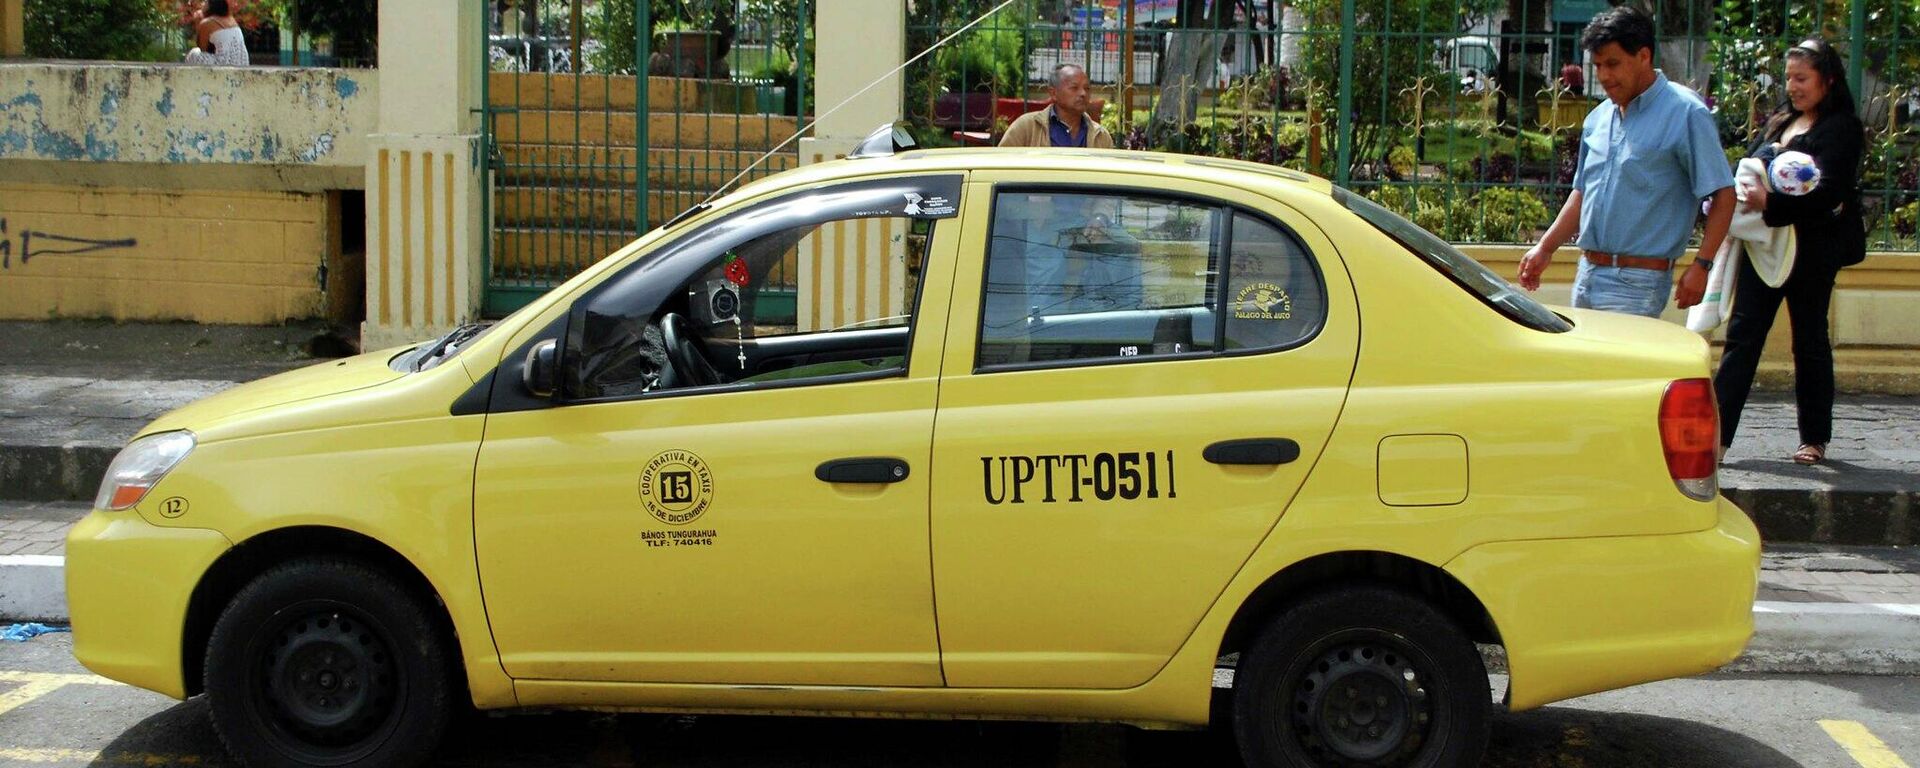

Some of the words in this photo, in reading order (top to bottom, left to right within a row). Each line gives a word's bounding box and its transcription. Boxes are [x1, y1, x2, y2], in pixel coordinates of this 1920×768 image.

[1258, 282, 1291, 312] DESPACIO
[1261, 311, 1273, 319] DEL
[641, 452, 685, 496] COOPERATIVA
[687, 456, 700, 469] EN
[698, 467, 711, 494] TAXIS
[980, 450, 1177, 505] UPTT-0511
[662, 475, 690, 500] 15
[166, 499, 181, 514] 12
[647, 500, 656, 512] 16
[656, 510, 667, 520] DE
[668, 498, 708, 523] DICIEMBRE
[646, 539, 670, 547] TLF:
[674, 538, 713, 546] 740416
[667, 529, 717, 539] TUNGURAHUA
